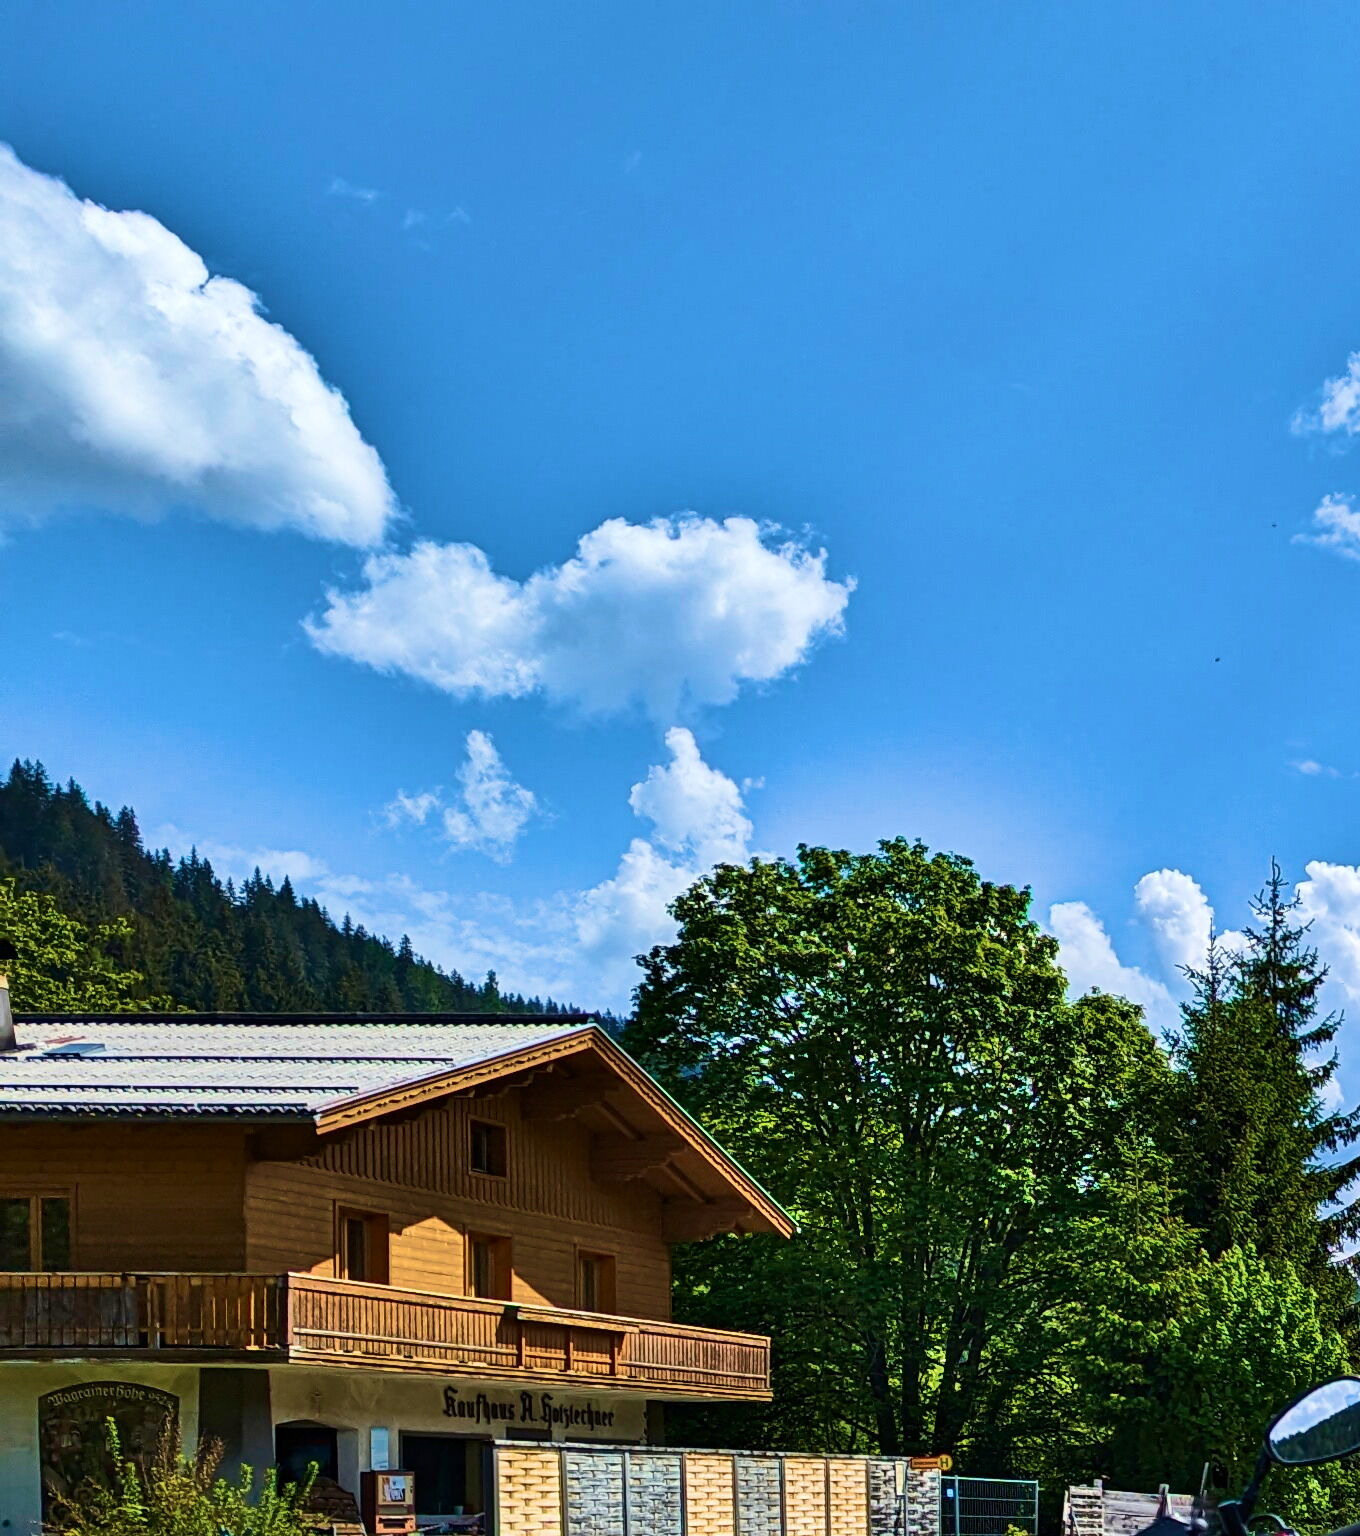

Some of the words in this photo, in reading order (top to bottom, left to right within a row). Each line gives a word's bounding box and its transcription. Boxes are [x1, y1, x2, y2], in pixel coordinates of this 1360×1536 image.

[48, 1384, 115, 1407] Wagrainer
[442, 1385, 516, 1425] Kaufhaus
[540, 1392, 615, 1431] Holzlechner
